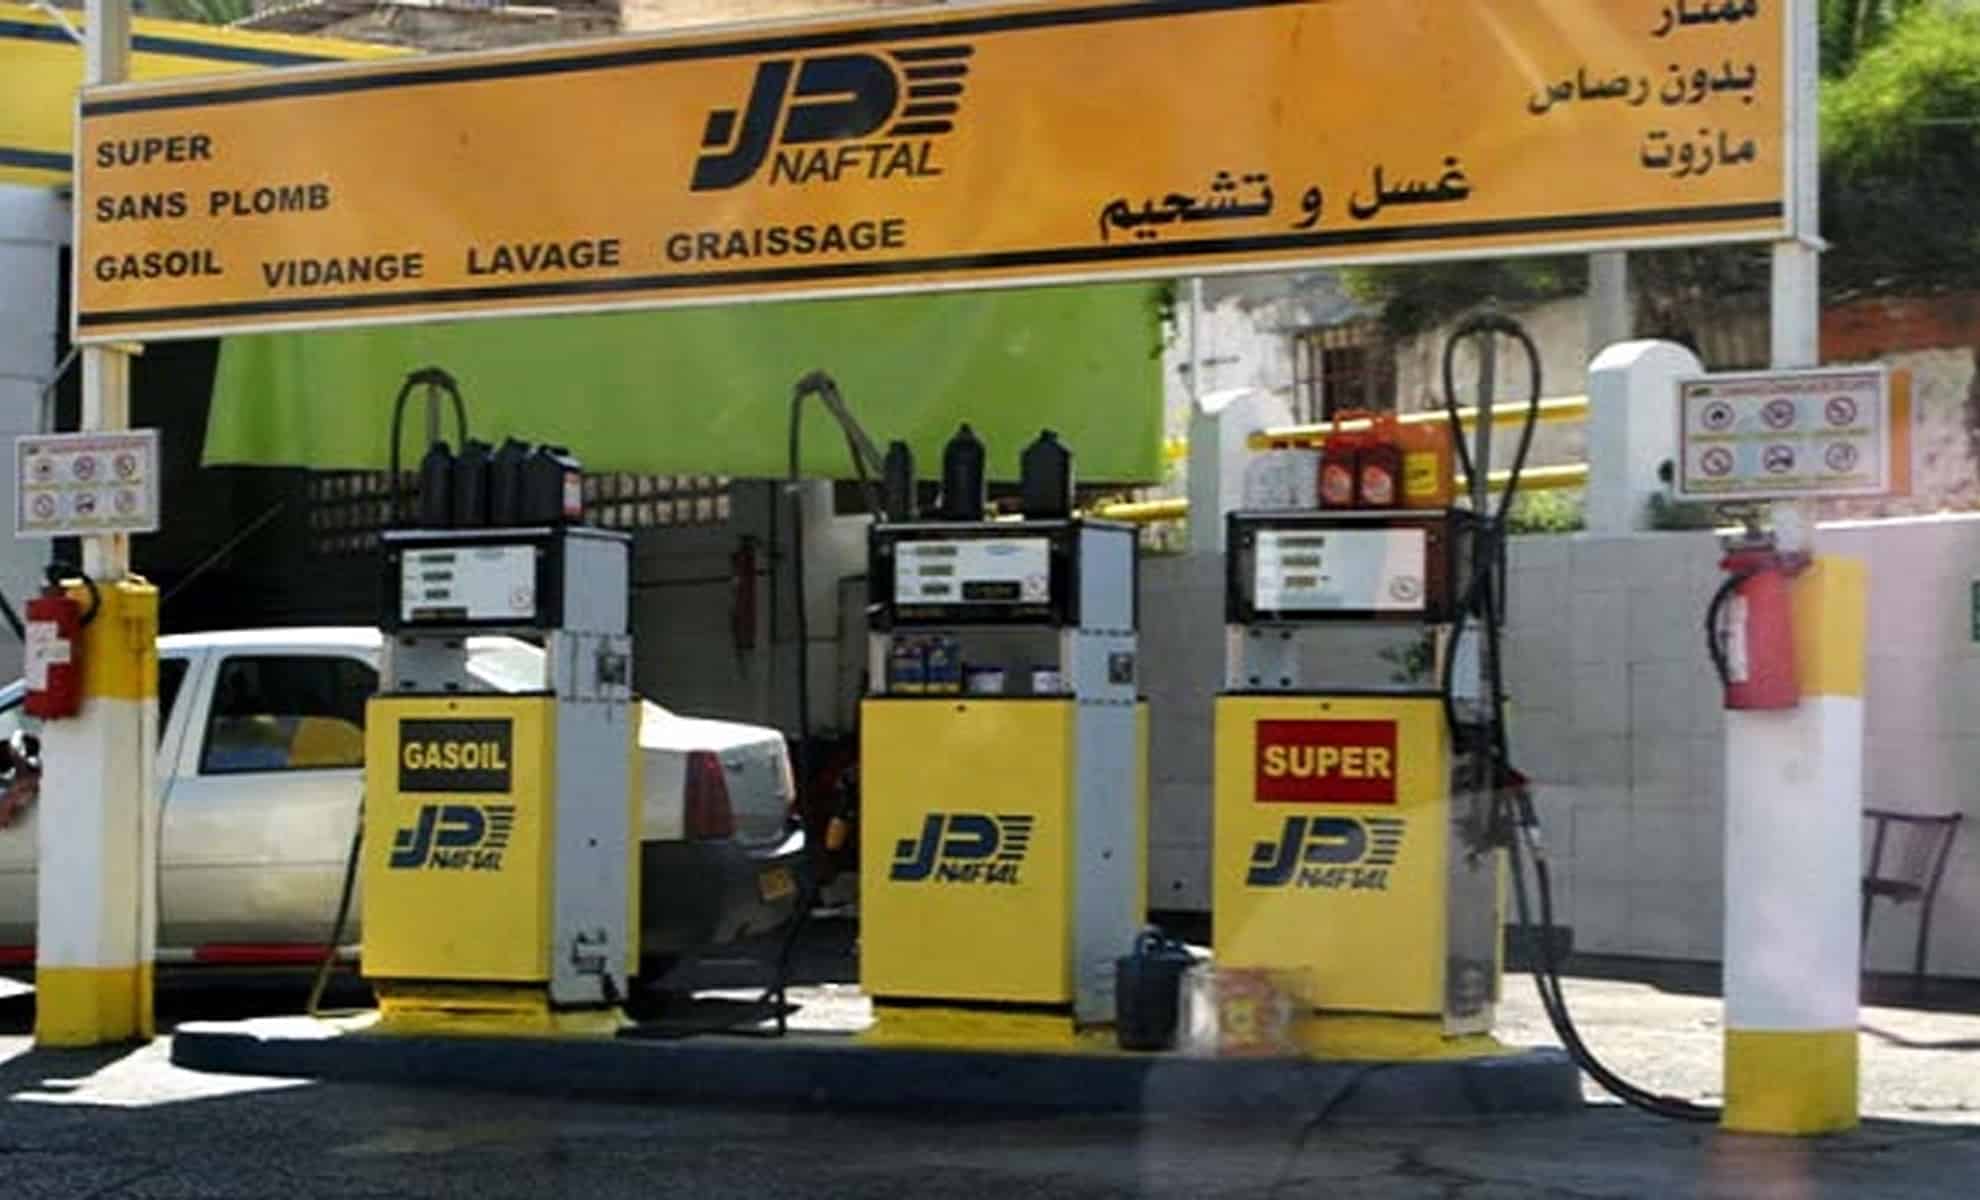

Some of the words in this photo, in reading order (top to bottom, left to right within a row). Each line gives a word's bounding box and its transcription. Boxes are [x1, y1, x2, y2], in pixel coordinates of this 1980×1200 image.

[1526, 67, 1650, 116] رصاص
[1661, 62, 1757, 104] بدون
[96, 134, 212, 168] SUPER
[768, 140, 944, 186] NAFTAL
[1640, 127, 1757, 178] مازوت
[96, 191, 188, 222] SANS
[209, 183, 330, 217] PLOMB
[1099, 170, 1275, 241] تشحيم
[1291, 186, 1324, 230] و
[1348, 156, 1472, 220] غسل
[95, 249, 223, 282] GASOIL
[262, 253, 425, 288] VIDANGE
[466, 239, 621, 276] LAVAGE
[665, 218, 906, 263] GRAISSAGE
[403, 741, 508, 770] GASOIL
[1263, 745, 1392, 779] SUPER
